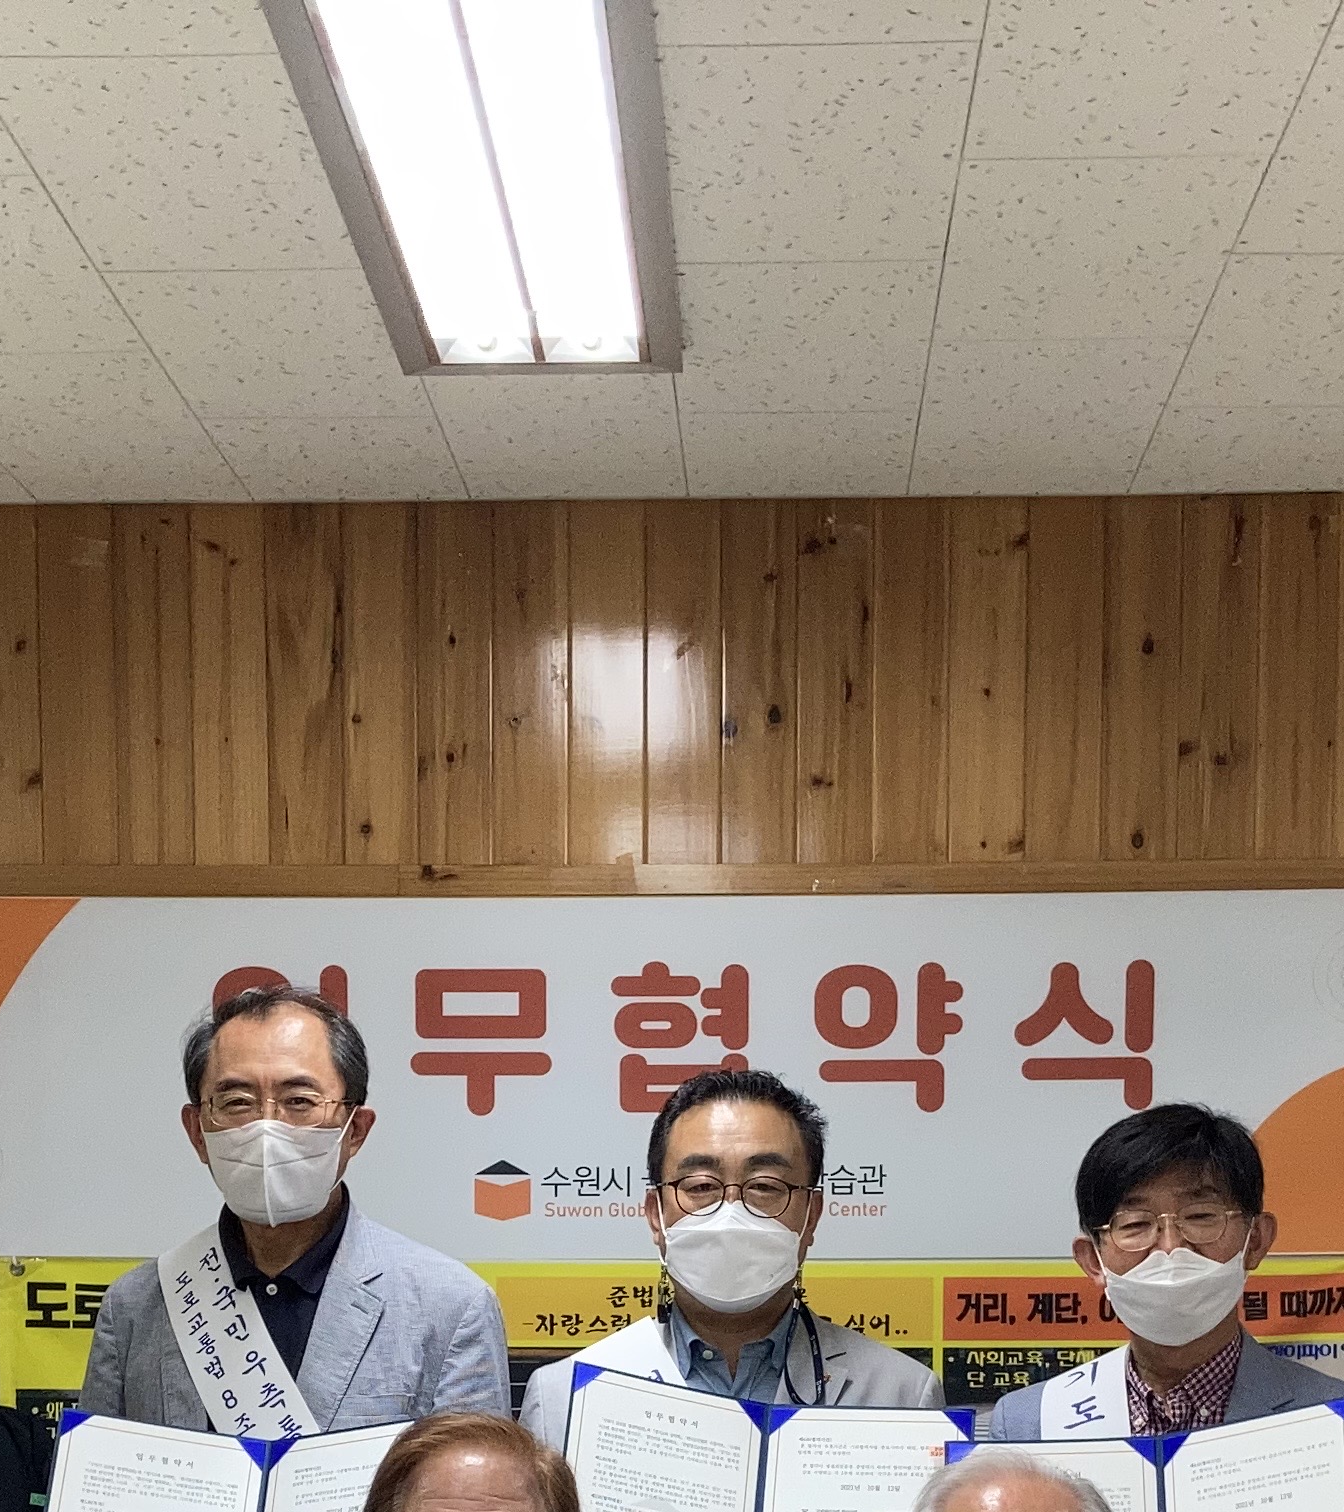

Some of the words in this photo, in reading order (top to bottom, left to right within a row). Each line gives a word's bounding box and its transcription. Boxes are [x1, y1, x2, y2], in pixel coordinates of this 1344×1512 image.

[213, 959, 1155, 1116] 무협약식
[541, 1166, 630, 1197] 수원시
[544, 1202, 603, 1218] Suwon
[828, 1201, 887, 1217] Center
[956, 1292, 1016, 1326] 거리,
[1027, 1292, 1088, 1326] 계단,
[175, 1271, 225, 1380] 도로교통법
[993, 1371, 1031, 1387] 교육
